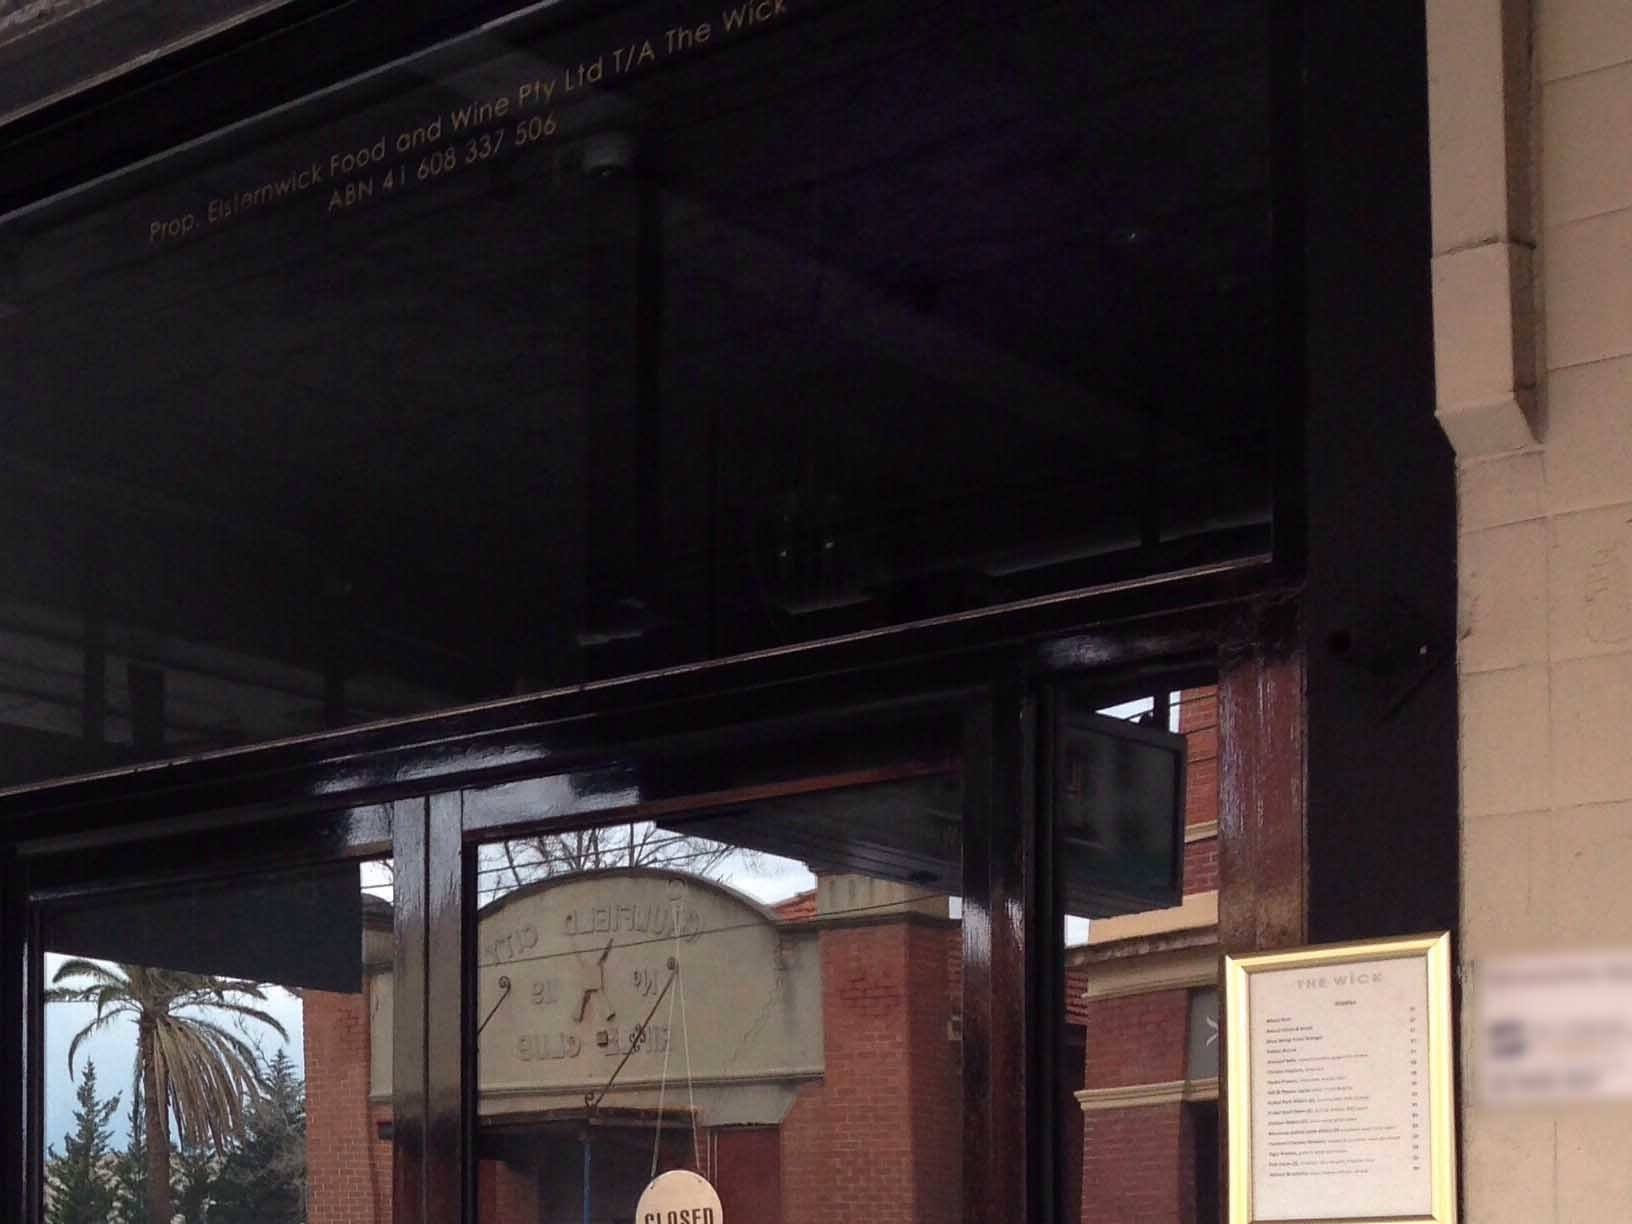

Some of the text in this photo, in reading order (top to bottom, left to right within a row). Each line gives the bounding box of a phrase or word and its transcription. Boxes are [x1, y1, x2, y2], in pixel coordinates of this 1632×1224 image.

[330, 138, 385, 176] Food
[396, 116, 441, 153] and
[452, 90, 509, 133] Wine
[519, 78, 556, 112] Pty
[565, 58, 603, 92] Ltd
[613, 39, 656, 76] T/A
[665, 20, 711, 55] The
[328, 178, 373, 212] ABN
[515, 113, 558, 145] 506
